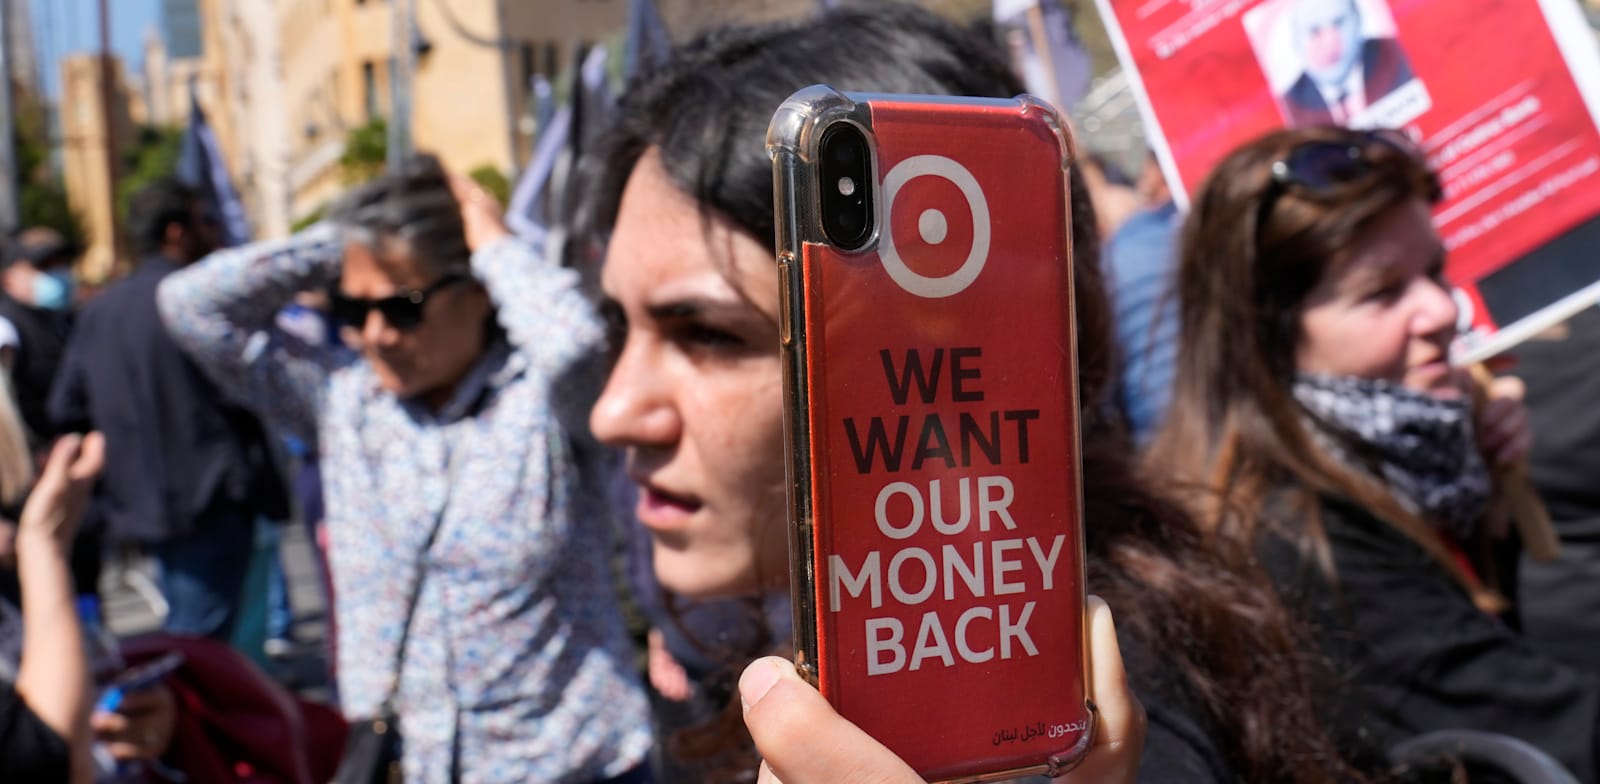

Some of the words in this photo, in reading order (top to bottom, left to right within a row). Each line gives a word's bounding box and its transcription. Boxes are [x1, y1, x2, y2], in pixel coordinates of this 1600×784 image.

[880, 347, 984, 405] WE
[843, 409, 1040, 474] WANT
[875, 475, 1016, 539] OUR
[828, 535, 1066, 612] MONEY
[865, 601, 1039, 676] BACK
[992, 728, 1018, 745] لبنان
[1021, 722, 1045, 742] لأجل
